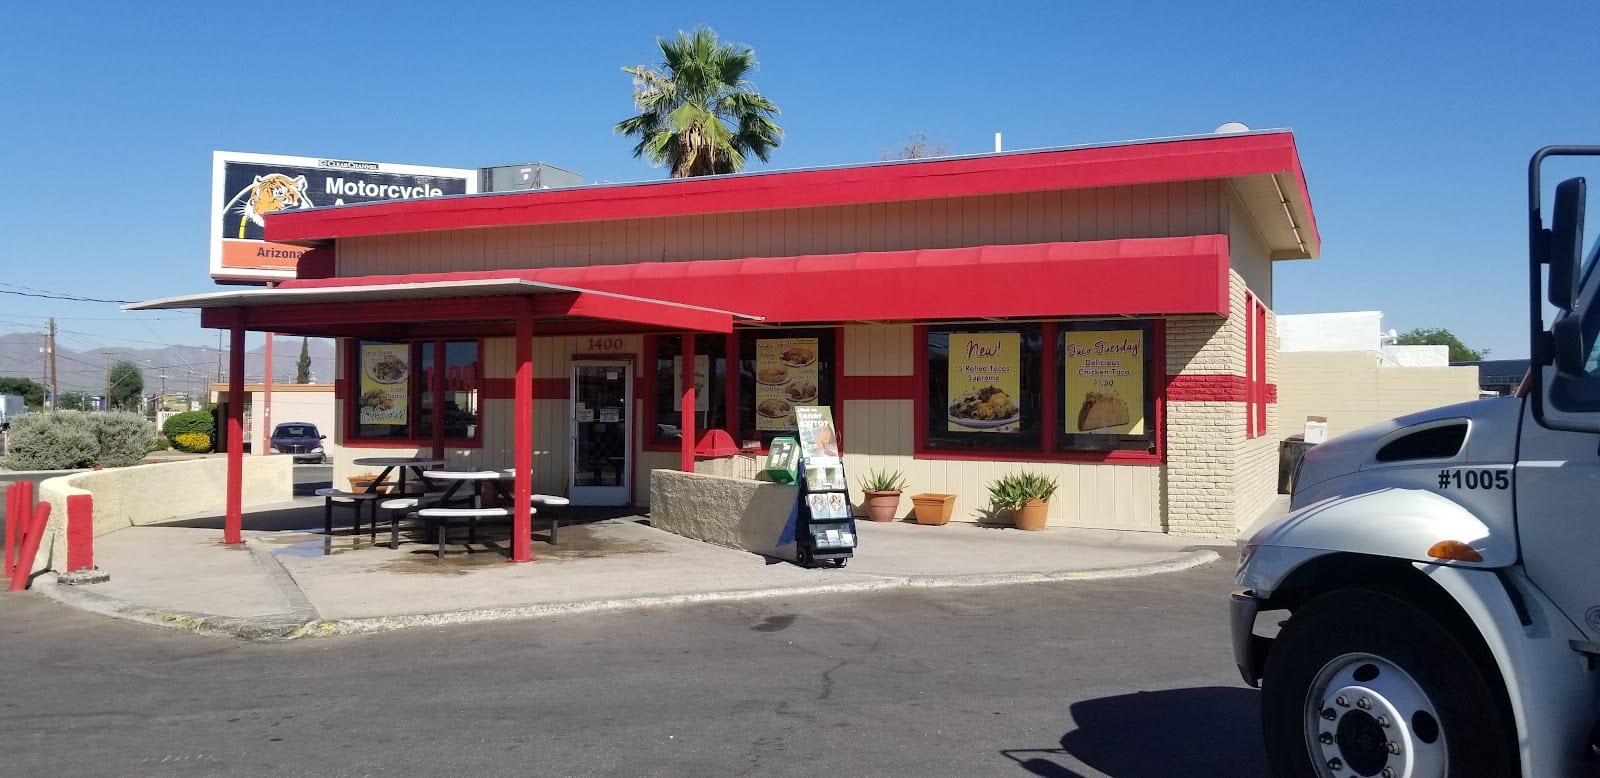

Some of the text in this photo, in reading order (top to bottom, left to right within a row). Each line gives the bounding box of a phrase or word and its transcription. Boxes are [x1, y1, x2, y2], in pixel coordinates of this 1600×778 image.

[326, 177, 443, 199] Motorcycle
[588, 338, 623, 351] 1400
[966, 338, 1002, 359] New!
[1066, 338, 1141, 357] Taco Tuesday!
[968, 374, 1000, 382] Supreme
[1079, 368, 1130, 376] Chicken Taco
[1438, 469, 1509, 490] #1005
